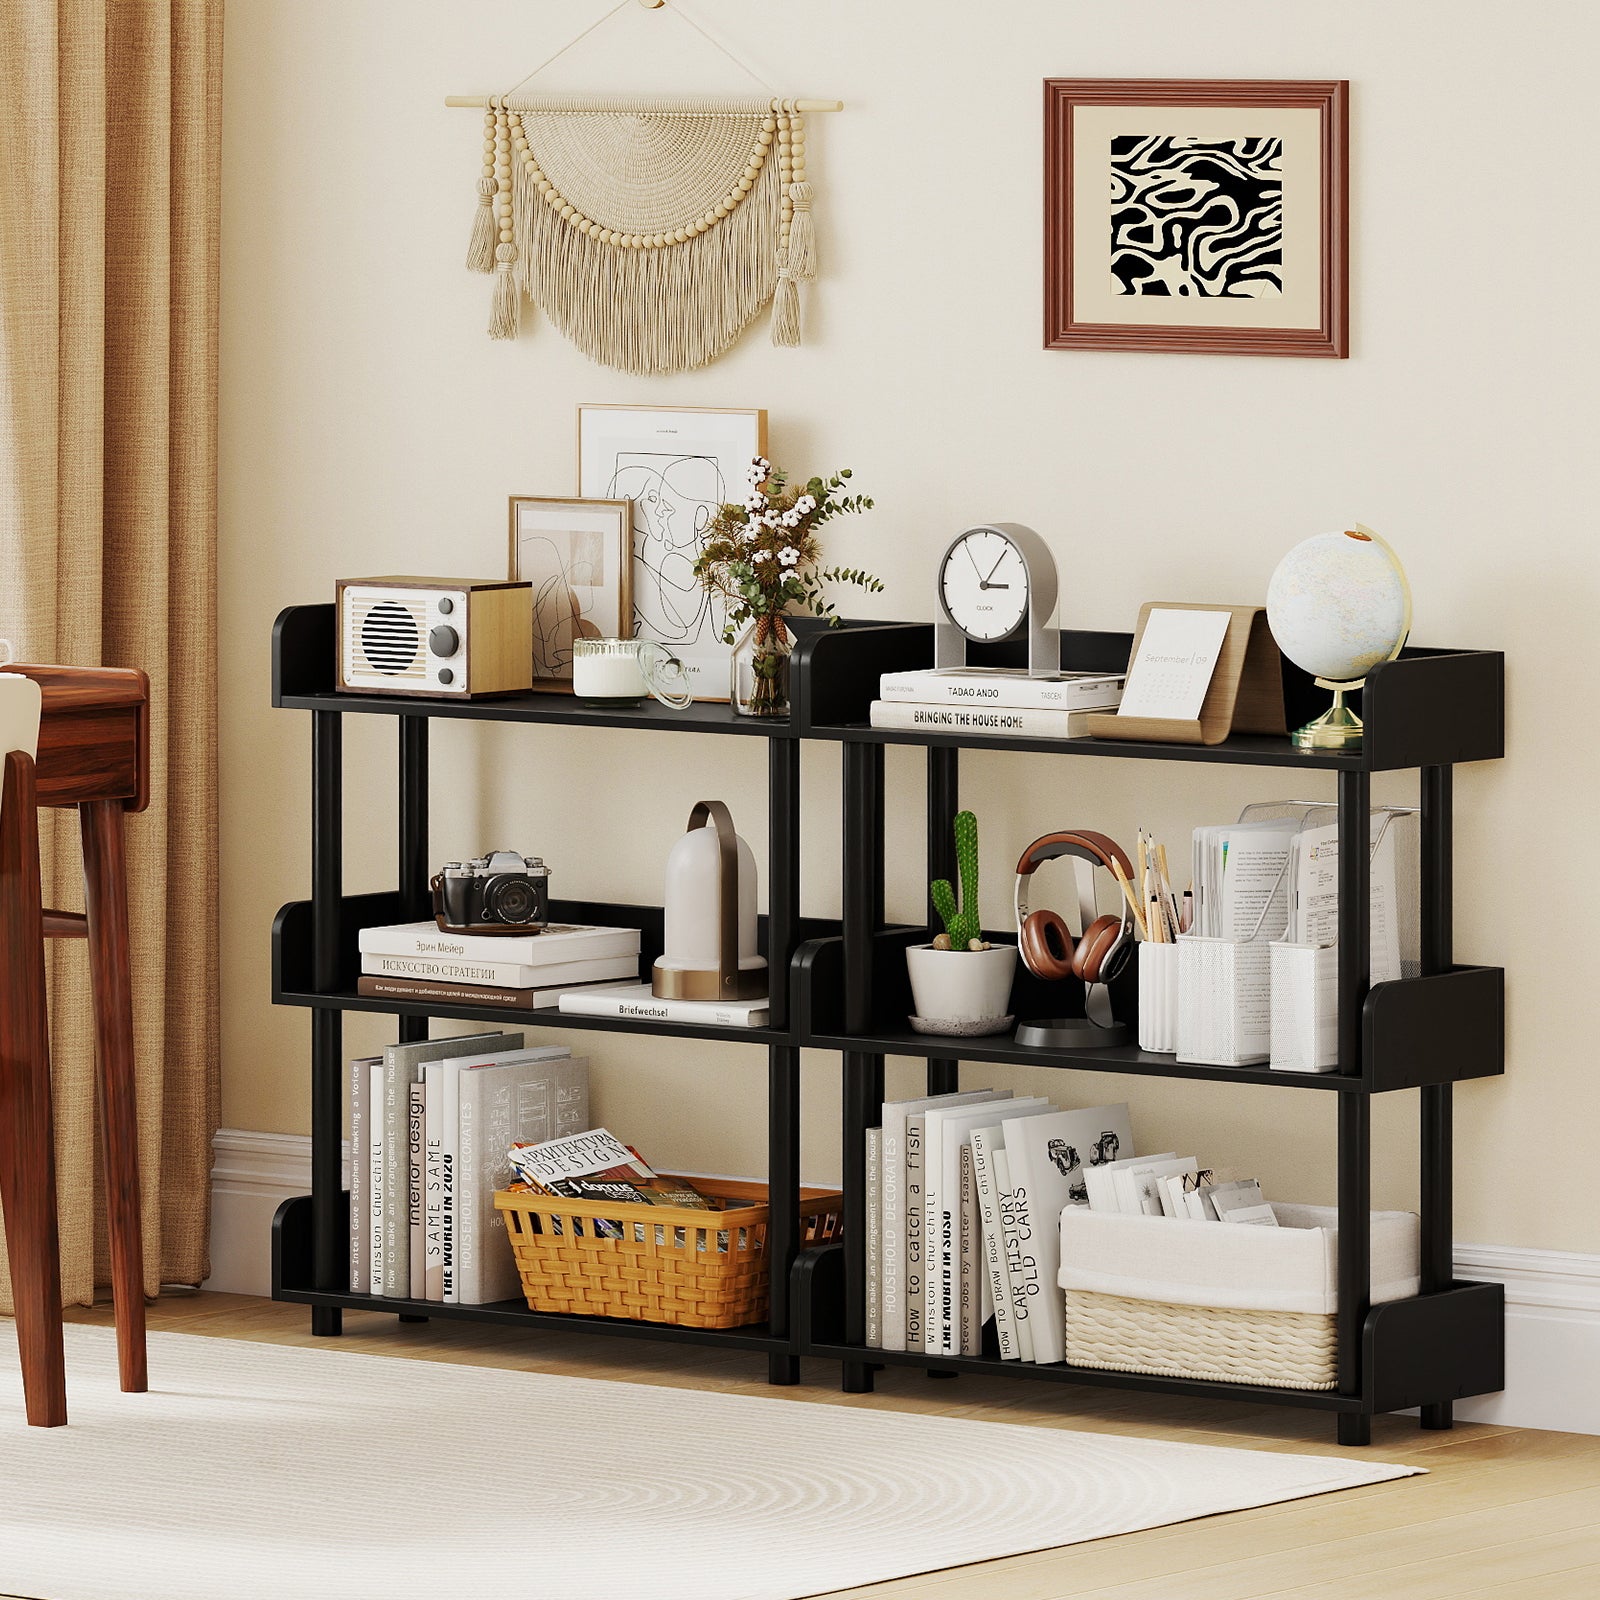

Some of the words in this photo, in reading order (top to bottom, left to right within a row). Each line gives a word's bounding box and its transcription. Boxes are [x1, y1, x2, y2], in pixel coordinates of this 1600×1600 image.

[1145, 653, 1189, 664] September
[947, 687, 974, 697] TADAO
[976, 688, 999, 698] ANDO
[914, 710, 952, 724] BRINGING
[955, 713, 970, 725] THE
[972, 714, 998, 727] HOUSE
[1000, 716, 1023, 728] HOME
[416, 940, 436, 952] Эрин
[438, 942, 464, 956] Мейер
[382, 959, 439, 975] ИСКУССТВО
[441, 965, 496, 980] СТРАТЕГИИ
[618, 1004, 668, 1017] Briefwechsel
[386, 1052, 395, 1083] house
[386, 1088, 395, 1106] the
[352, 1113, 361, 1154] Hawking
[387, 1113, 395, 1125] in
[409, 1091, 424, 1154] design
[461, 1102, 472, 1181] DECORATES
[521, 1132, 618, 1165] АРХИТЕКТУРА
[869, 1133, 877, 1161] house
[907, 1126, 920, 1171] fish
[387, 1131, 397, 1197] arrangement
[428, 1139, 440, 1191] SAME
[443, 1154, 453, 1193] 2020
[538, 1144, 627, 1176] DESIGN
[868, 1165, 876, 1181] the
[974, 1134, 989, 1195] children
[352, 1159, 361, 1200] Stephen
[373, 1142, 382, 1217] Churchill
[409, 1160, 421, 1226] Interior
[580, 1180, 634, 1192] domus
[869, 1186, 876, 1196] in
[885, 1137, 897, 1220] DECORATES
[910, 1183, 920, 1194] a
[388, 1203, 395, 1216] an
[443, 1196, 453, 1208] IN
[984, 1206, 993, 1224] for
[1012, 1187, 1032, 1241] CARS
[386, 1221, 395, 1246] make
[428, 1203, 440, 1256] SAME
[443, 1214, 453, 1267] WORLD
[461, 1189, 472, 1269] HOUSEHOLD
[869, 1202, 878, 1262] arrangement
[907, 1206, 920, 1262] catch
[926, 1192, 936, 1271] Churchill
[998, 1191, 1023, 1273] HISTORY
[373, 1225, 382, 1285] Winston
[387, 1252, 395, 1263] to
[870, 1265, 876, 1276] an
[962, 1260, 971, 1275] by
[386, 1269, 395, 1288] How
[443, 1270, 453, 1297] THE
[885, 1230, 897, 1313] HOUSEHOLD
[907, 1274, 920, 1296] to
[992, 1270, 1004, 1301] DRAW
[1022, 1255, 1040, 1296] OLD
[868, 1281, 876, 1307] make
[1012, 1285, 1029, 1320] CAR
[869, 1307, 876, 1318] to
[907, 1308, 920, 1343] How
[926, 1281, 936, 1344] Winston
[997, 1308, 1006, 1324] TO
[1000, 1331, 1011, 1354] HOW
